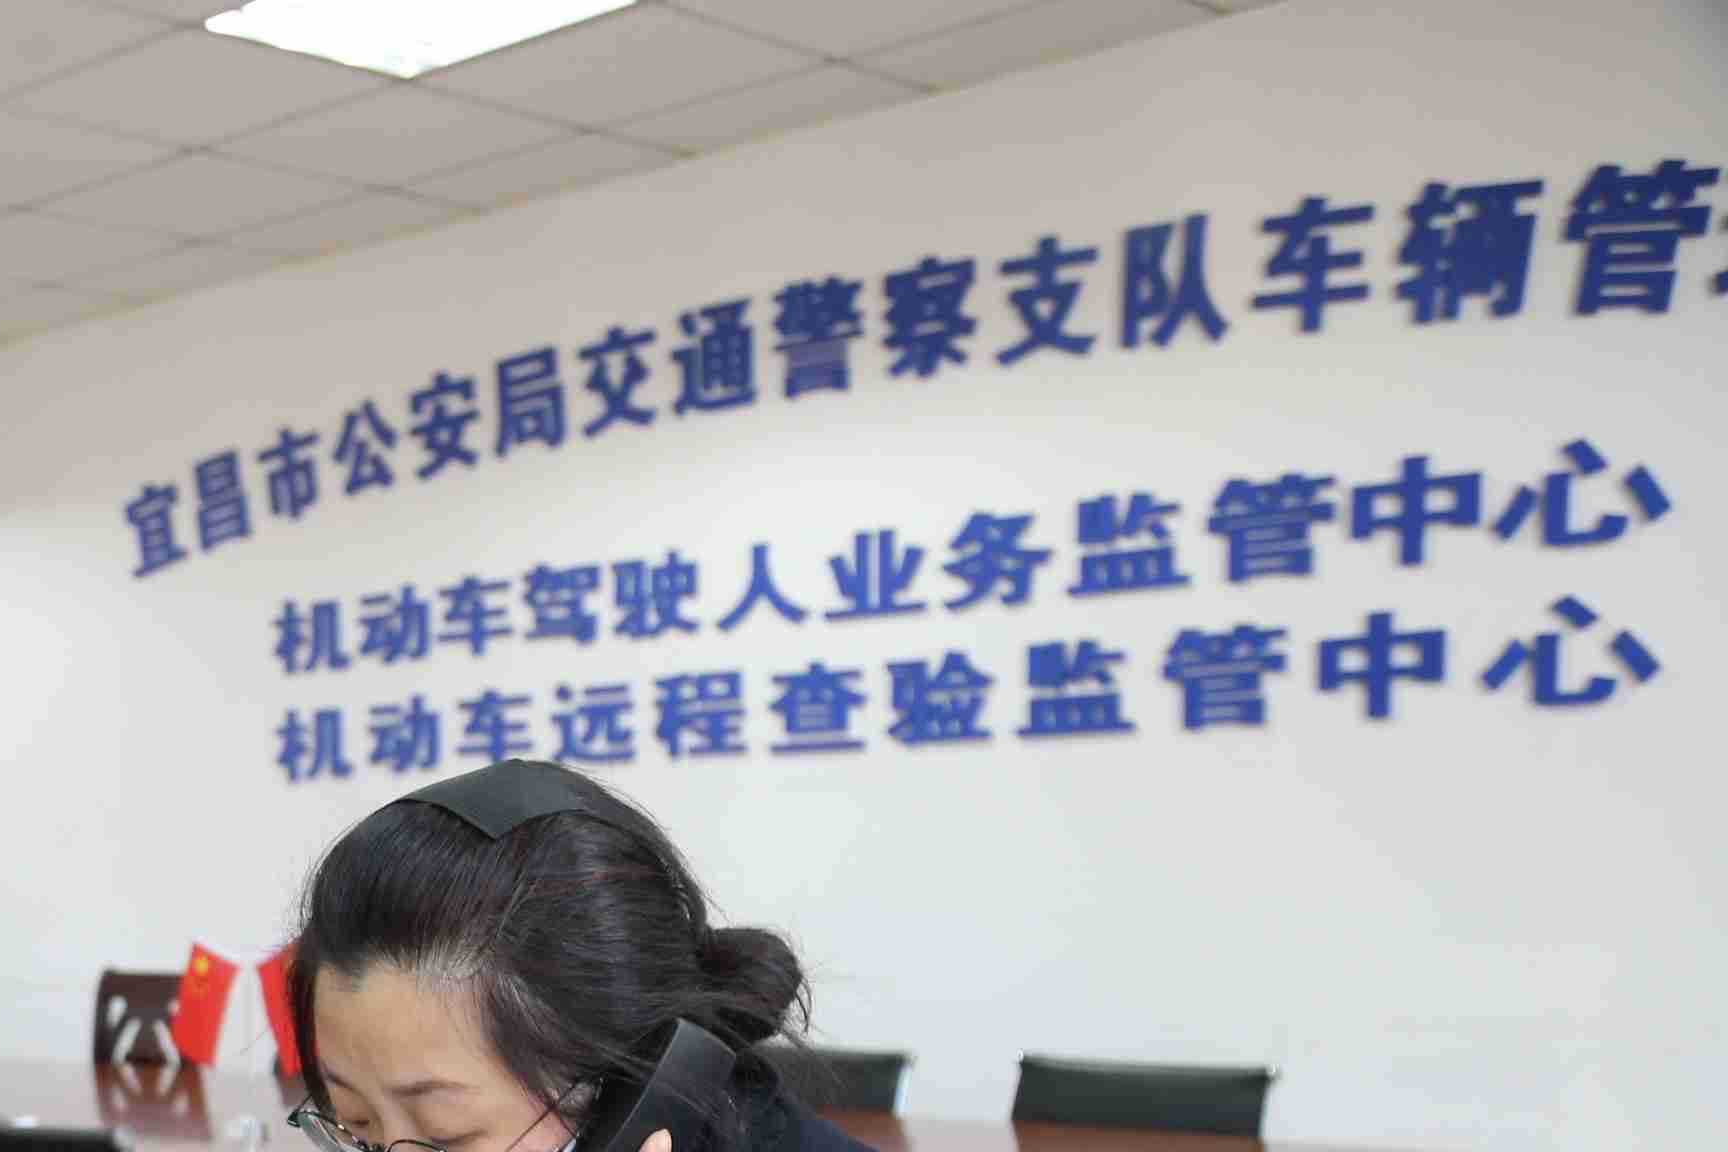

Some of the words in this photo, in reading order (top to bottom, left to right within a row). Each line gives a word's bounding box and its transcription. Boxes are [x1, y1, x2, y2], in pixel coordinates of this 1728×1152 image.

[124, 160, 1728, 577] 宜昌市公安局交通警察支队车辆管
[274, 438, 1670, 674] 机动车驾驶人业务监管中心
[276, 596, 1661, 782] 机动车远程查验监管中心
